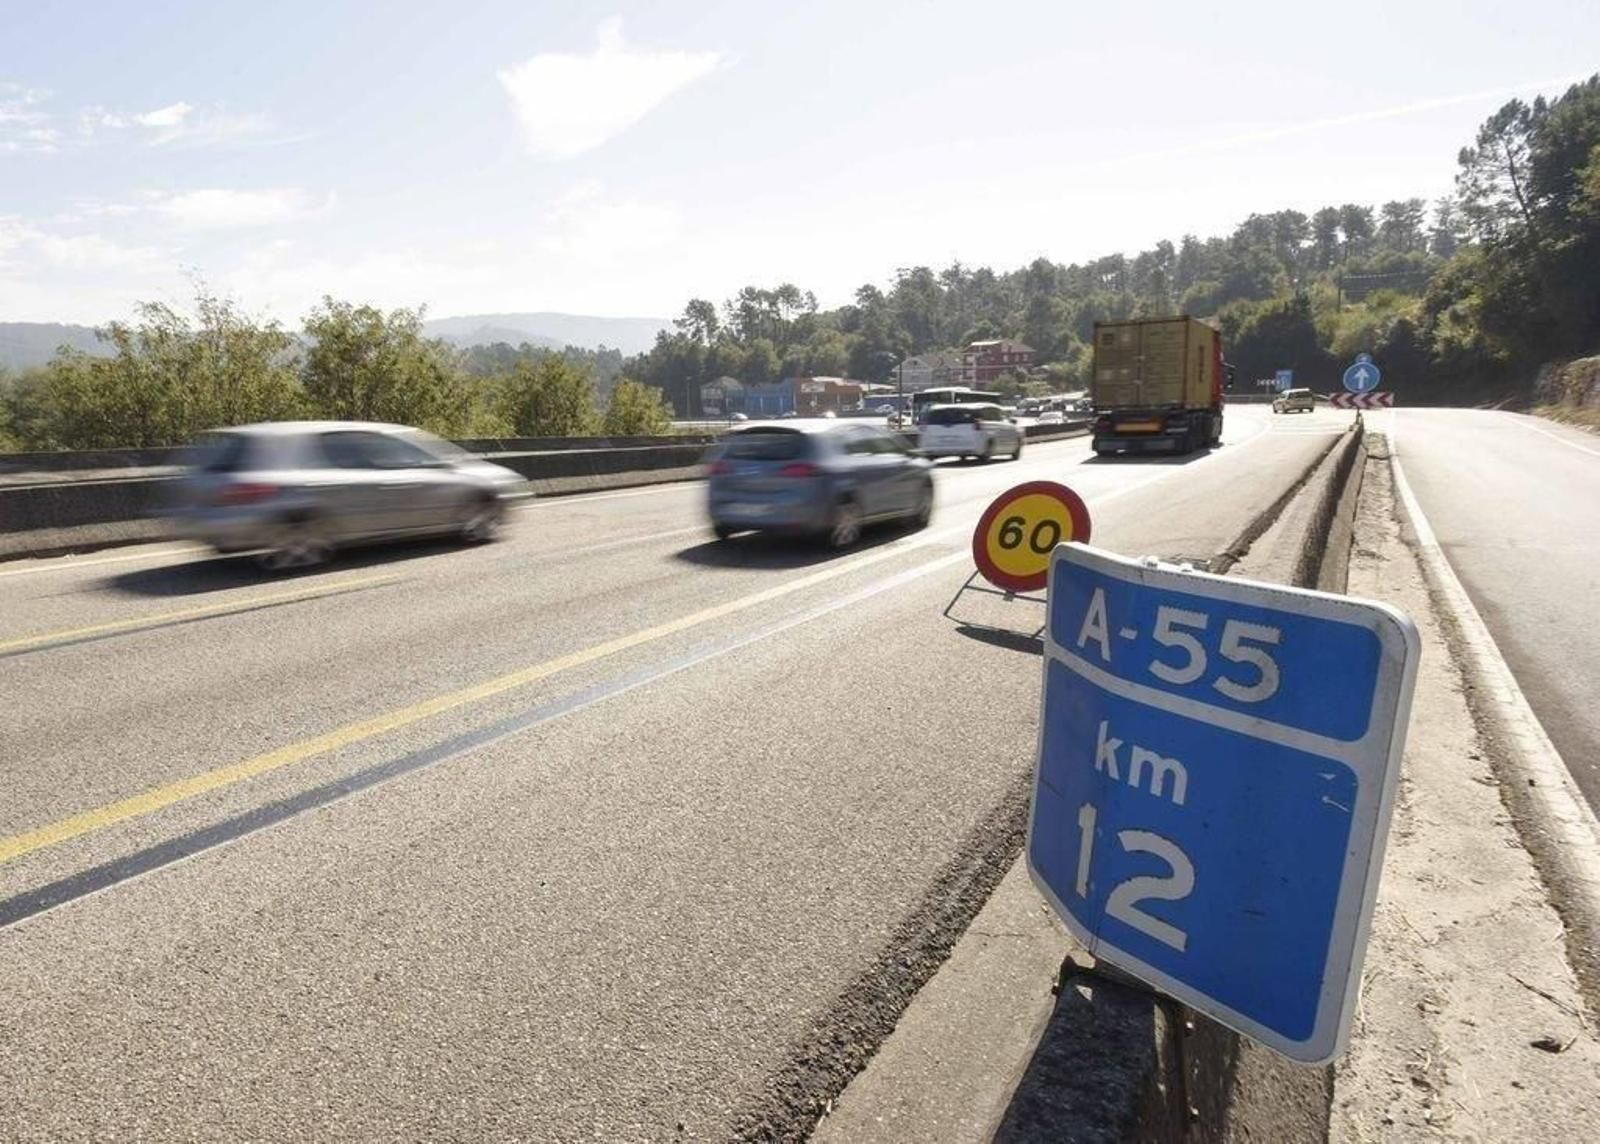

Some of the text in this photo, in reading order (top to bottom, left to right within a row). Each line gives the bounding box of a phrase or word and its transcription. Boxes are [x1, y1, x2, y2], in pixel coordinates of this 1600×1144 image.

[998, 516, 1061, 554] 60
[1077, 588, 1282, 703] A-55
[1095, 721, 1188, 805] km
[1075, 803, 1195, 952] 12
